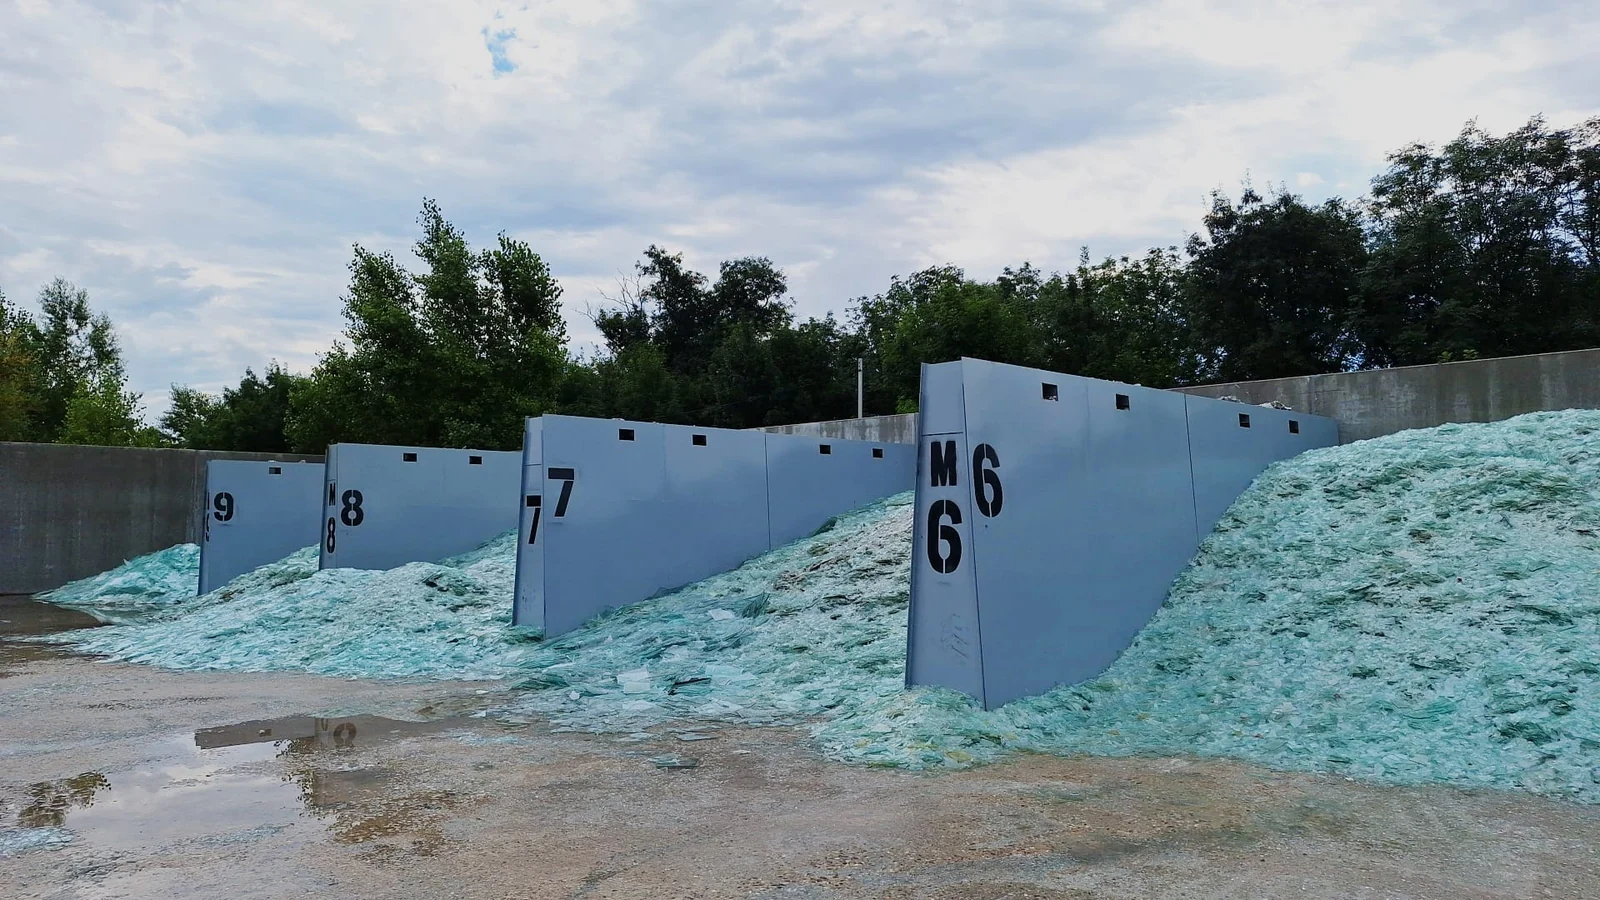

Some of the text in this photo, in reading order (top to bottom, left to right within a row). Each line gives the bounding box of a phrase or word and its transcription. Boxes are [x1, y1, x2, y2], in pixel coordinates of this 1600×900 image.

[930, 440, 957, 487] M
[973, 443, 1003, 518] 6
[213, 492, 234, 521] 9
[341, 489, 364, 526] 8
[548, 467, 575, 517] 7
[327, 517, 336, 553] 8
[526, 495, 542, 545] 7
[927, 500, 962, 574] 6
